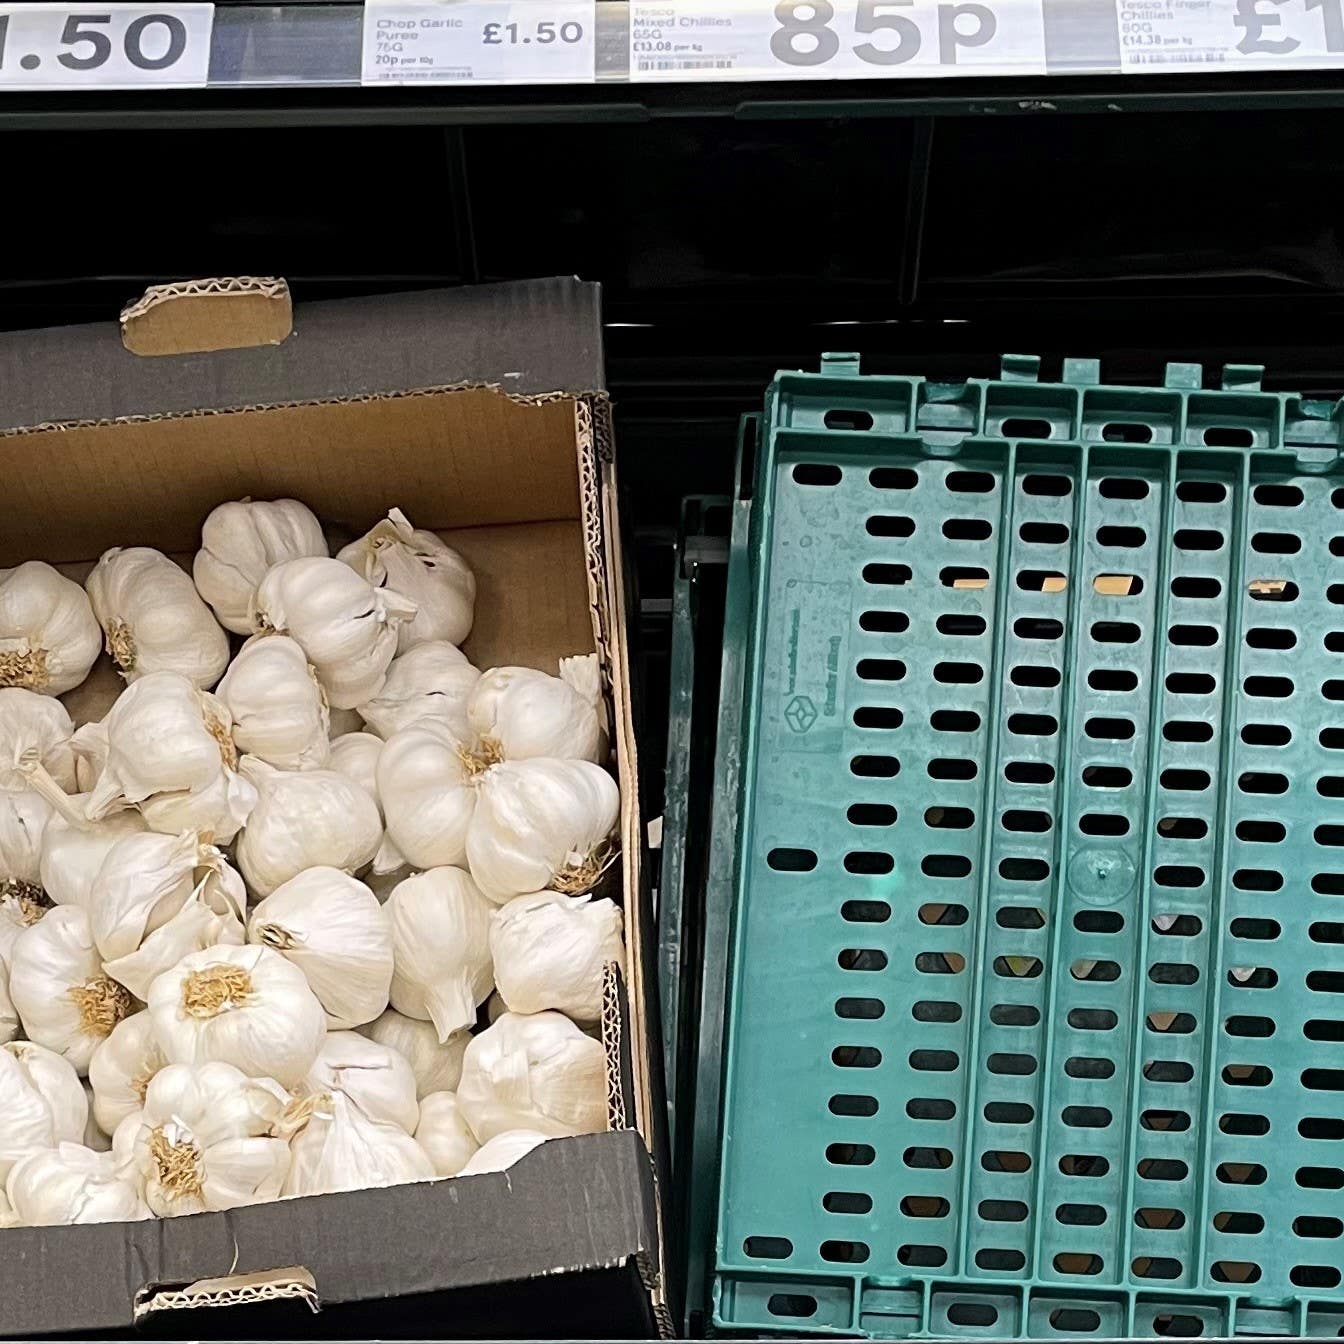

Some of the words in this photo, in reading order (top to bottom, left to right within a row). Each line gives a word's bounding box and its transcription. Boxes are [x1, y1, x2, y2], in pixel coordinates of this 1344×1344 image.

[376, 19, 417, 30] Chop
[420, 18, 463, 28] Garlic
[633, 17, 675, 28] Mixed
[482, 22, 584, 45] £1.50
[769, 0, 998, 66] 85p
[375, 54, 399, 65] 20p
